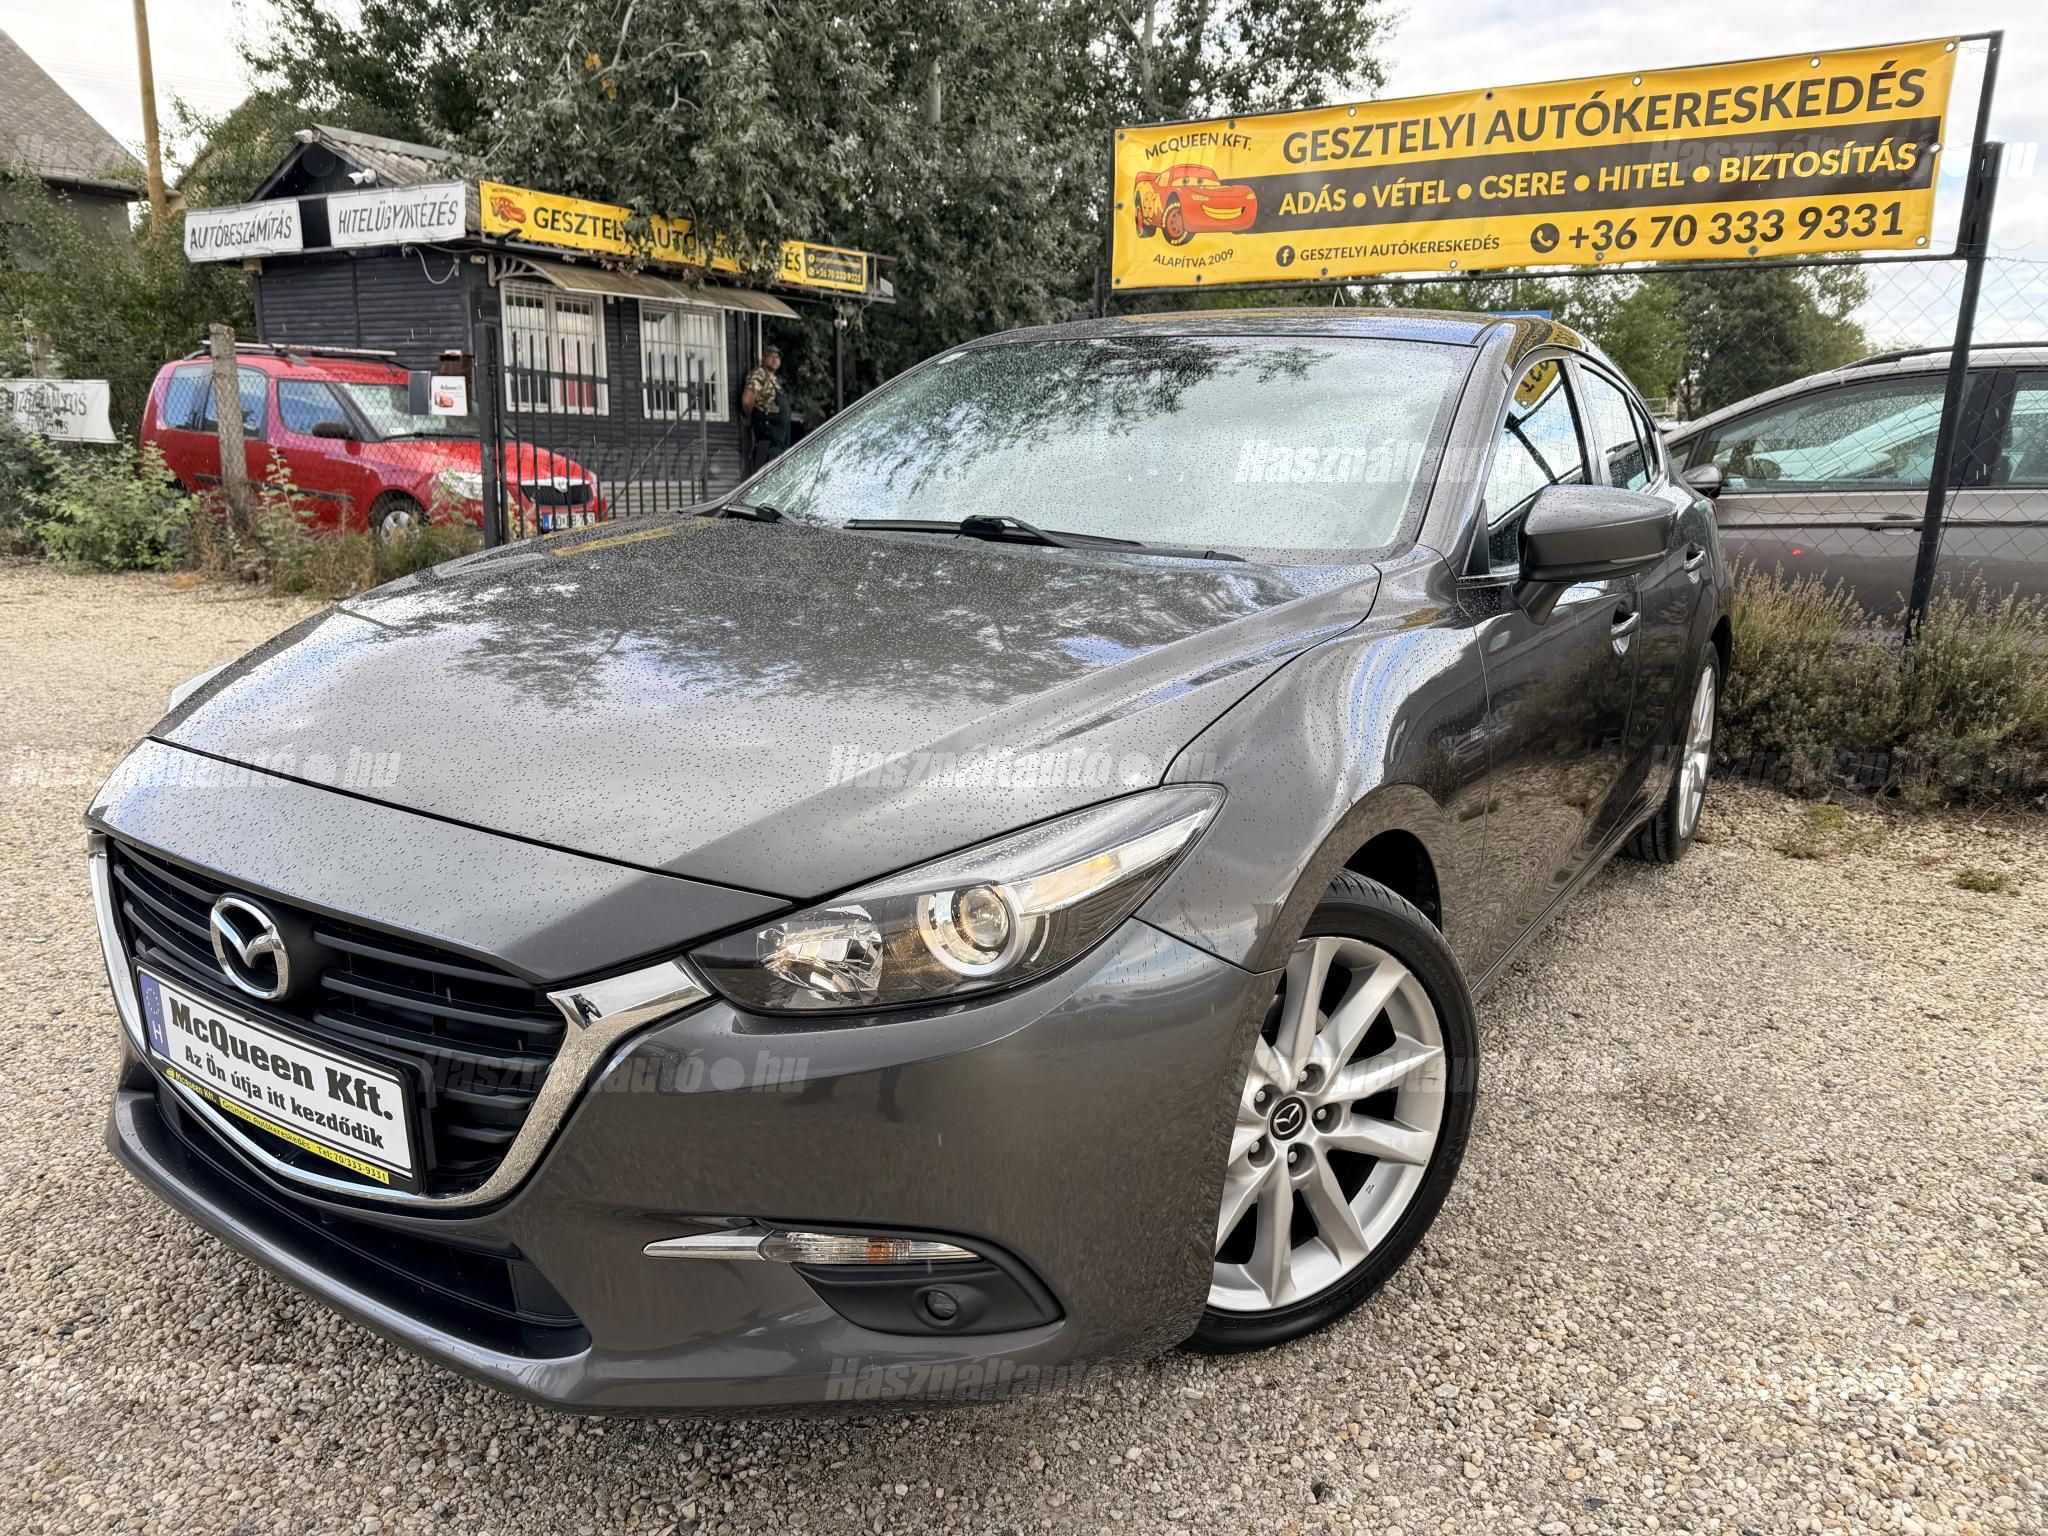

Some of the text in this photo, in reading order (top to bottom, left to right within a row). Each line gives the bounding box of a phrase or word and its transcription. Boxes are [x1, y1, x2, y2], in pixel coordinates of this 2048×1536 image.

[1284, 59, 1928, 164] GESZTELYI AUTÓKERESKEDÉS
[1144, 131, 1253, 161] MCQUEEN KFT.
[1279, 136, 1917, 216] ADÁS VÉTEL CSERE HITEL BIZTOSÍTÁS
[190, 211, 293, 249] AUTÓBESZÁMÍTÁS
[338, 193, 459, 234] HITELÜGYINTÉZÉS
[1568, 201, 1903, 252] +36 70 333 9331
[1153, 248, 1234, 268] ALAPÍTVA 2009
[1300, 236, 1501, 262] GESZTELYI AUTÓKERESKEDÉS
[152, 1020, 164, 1044] H
[168, 996, 394, 1121] McQueen Kft.
[185, 1044, 385, 1150] Az Ön útja itt kezdődik
